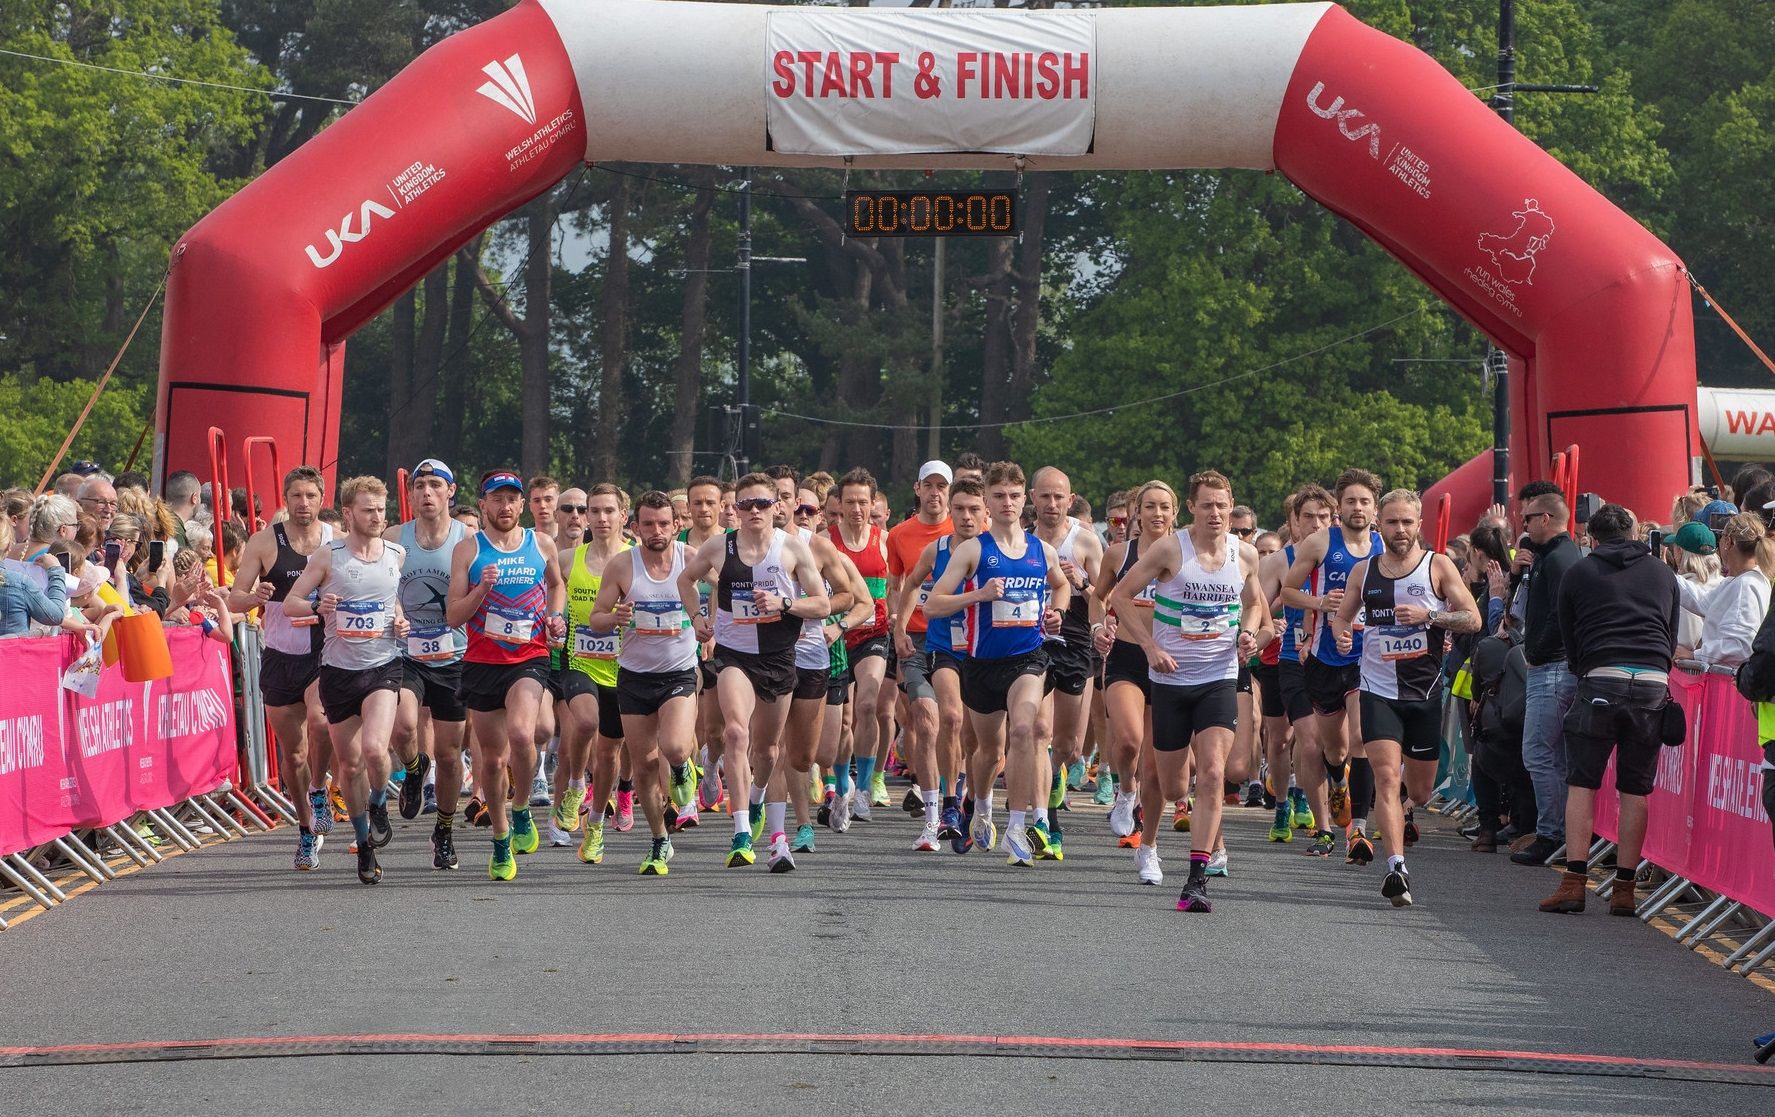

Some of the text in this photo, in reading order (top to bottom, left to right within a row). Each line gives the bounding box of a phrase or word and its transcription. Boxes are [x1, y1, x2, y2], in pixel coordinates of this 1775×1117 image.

[772, 50, 1089, 99] START & FINISH
[505, 109, 573, 161] WELSH ATHLETICS
[509, 120, 577, 172] ATHLETAU CYMRU
[1400, 146, 1430, 173] UNITED
[392, 161, 422, 187] UNITED
[1394, 154, 1431, 187] KINGDOM
[398, 163, 436, 196] KINGDOM
[404, 168, 446, 205] ATHLETICS
[1388, 164, 1432, 199] ATHLETICS
[854, 195, 1011, 232] 00:00:00
[305, 200, 396, 268] UKA
[1475, 265, 1516, 302] run wales
[1463, 267, 1523, 318] rhedeg cymru
[497, 556, 525, 566] MIKE
[507, 567, 537, 576] HARD
[1328, 571, 1346, 582] CA
[495, 576, 535, 586] ARRIERS
[731, 580, 775, 588] PONTYPRIDD
[1004, 576, 1043, 590] RDIFF
[1185, 582, 1235, 593] SWANSEA
[1183, 591, 1238, 602] HARRIERS
[742, 604, 769, 617] 13
[1012, 606, 1022, 618] 4
[345, 617, 374, 629] 703
[503, 622, 513, 634] 8
[655, 616, 660, 628] 1
[1201, 620, 1211, 632] 2
[421, 640, 440, 653] 38
[579, 639, 614, 652] 1024
[1385, 638, 1422, 652] 1440
[17, 714, 45, 771] CYMRU
